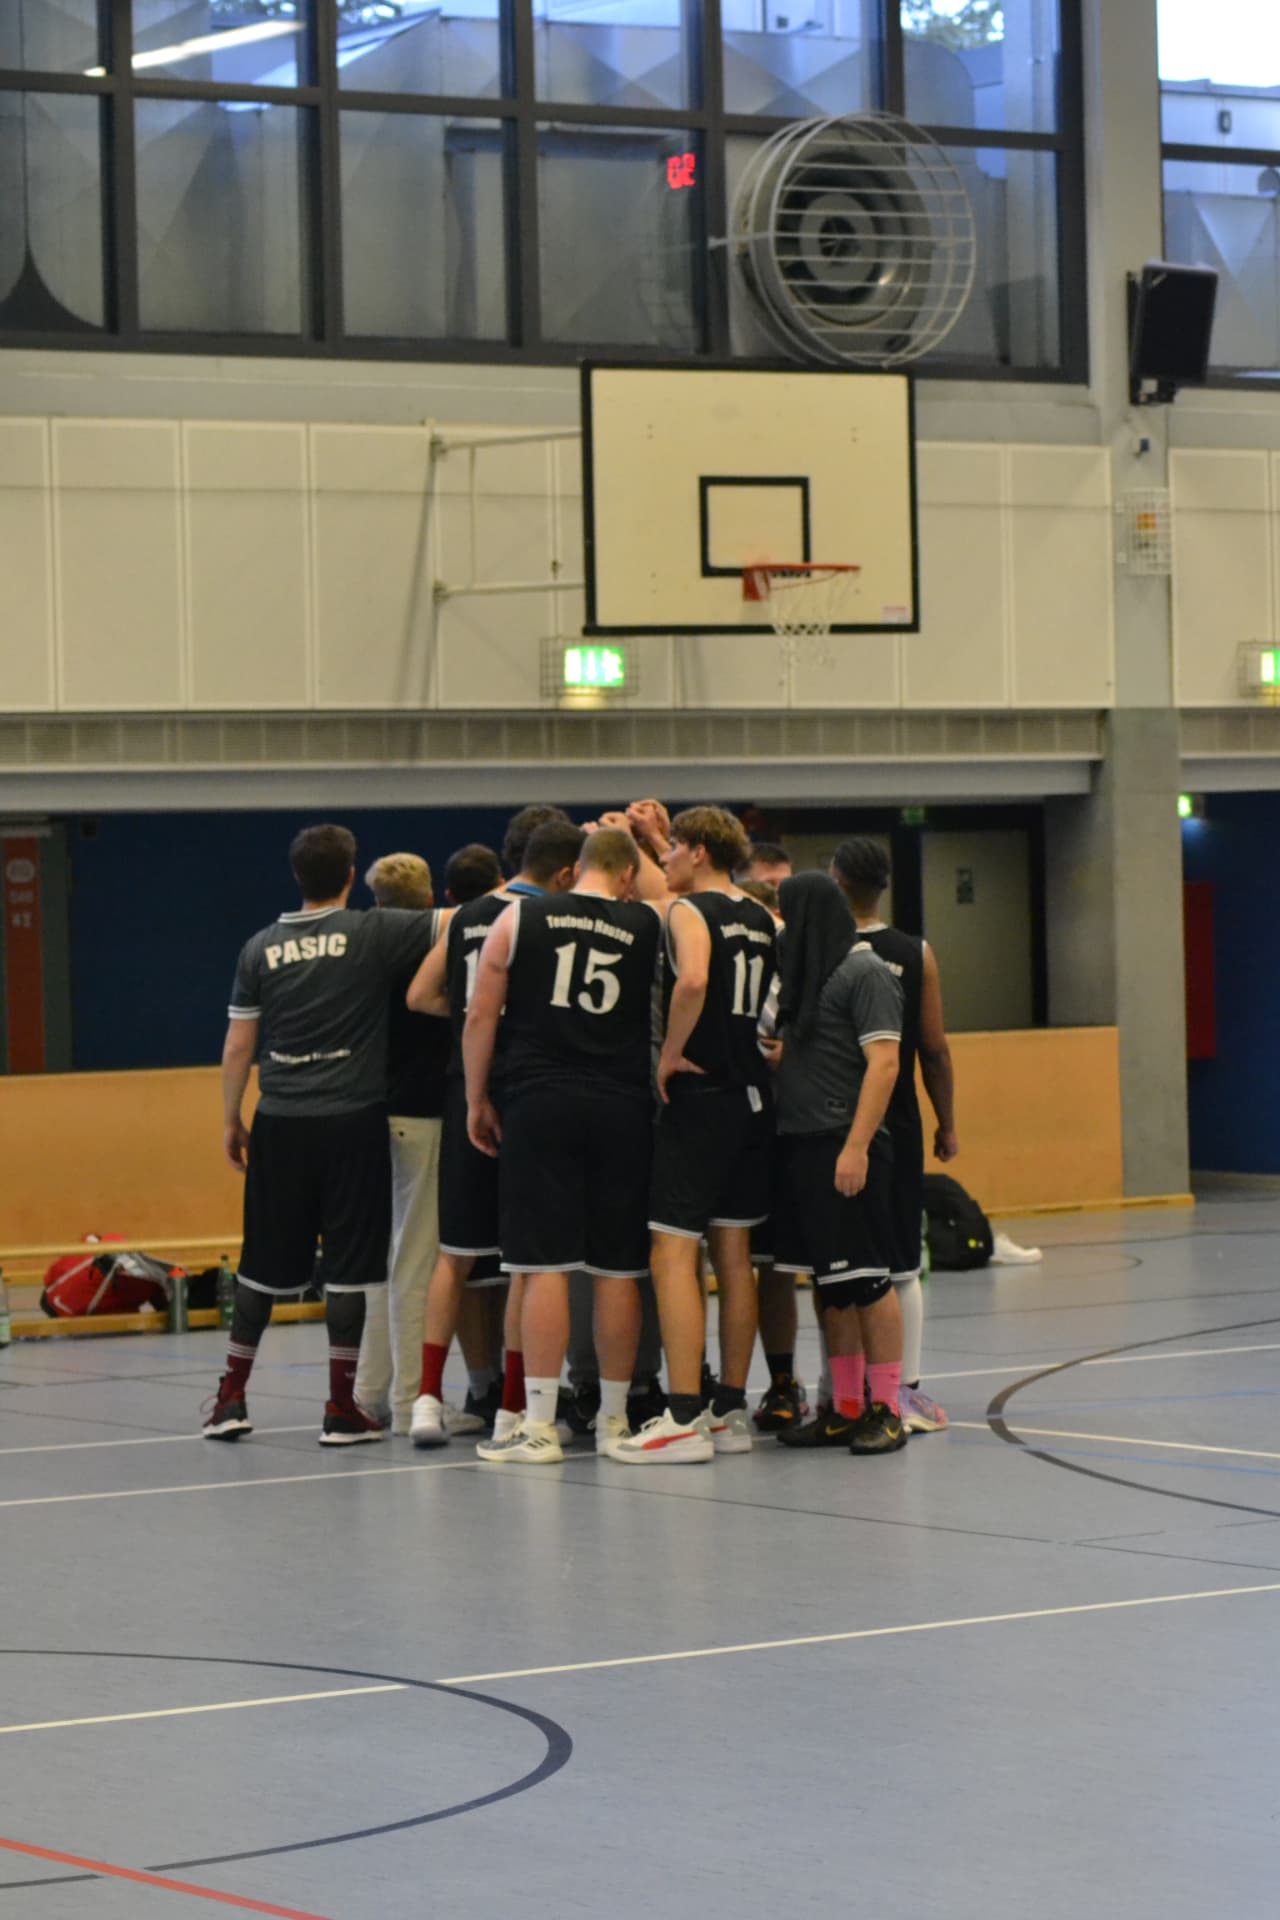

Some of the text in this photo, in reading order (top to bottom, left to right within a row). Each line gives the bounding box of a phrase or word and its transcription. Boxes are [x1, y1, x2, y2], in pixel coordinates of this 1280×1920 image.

[265, 932, 348, 971] PASIC
[550, 941, 623, 1015] 15
[731, 949, 764, 1018] 11
